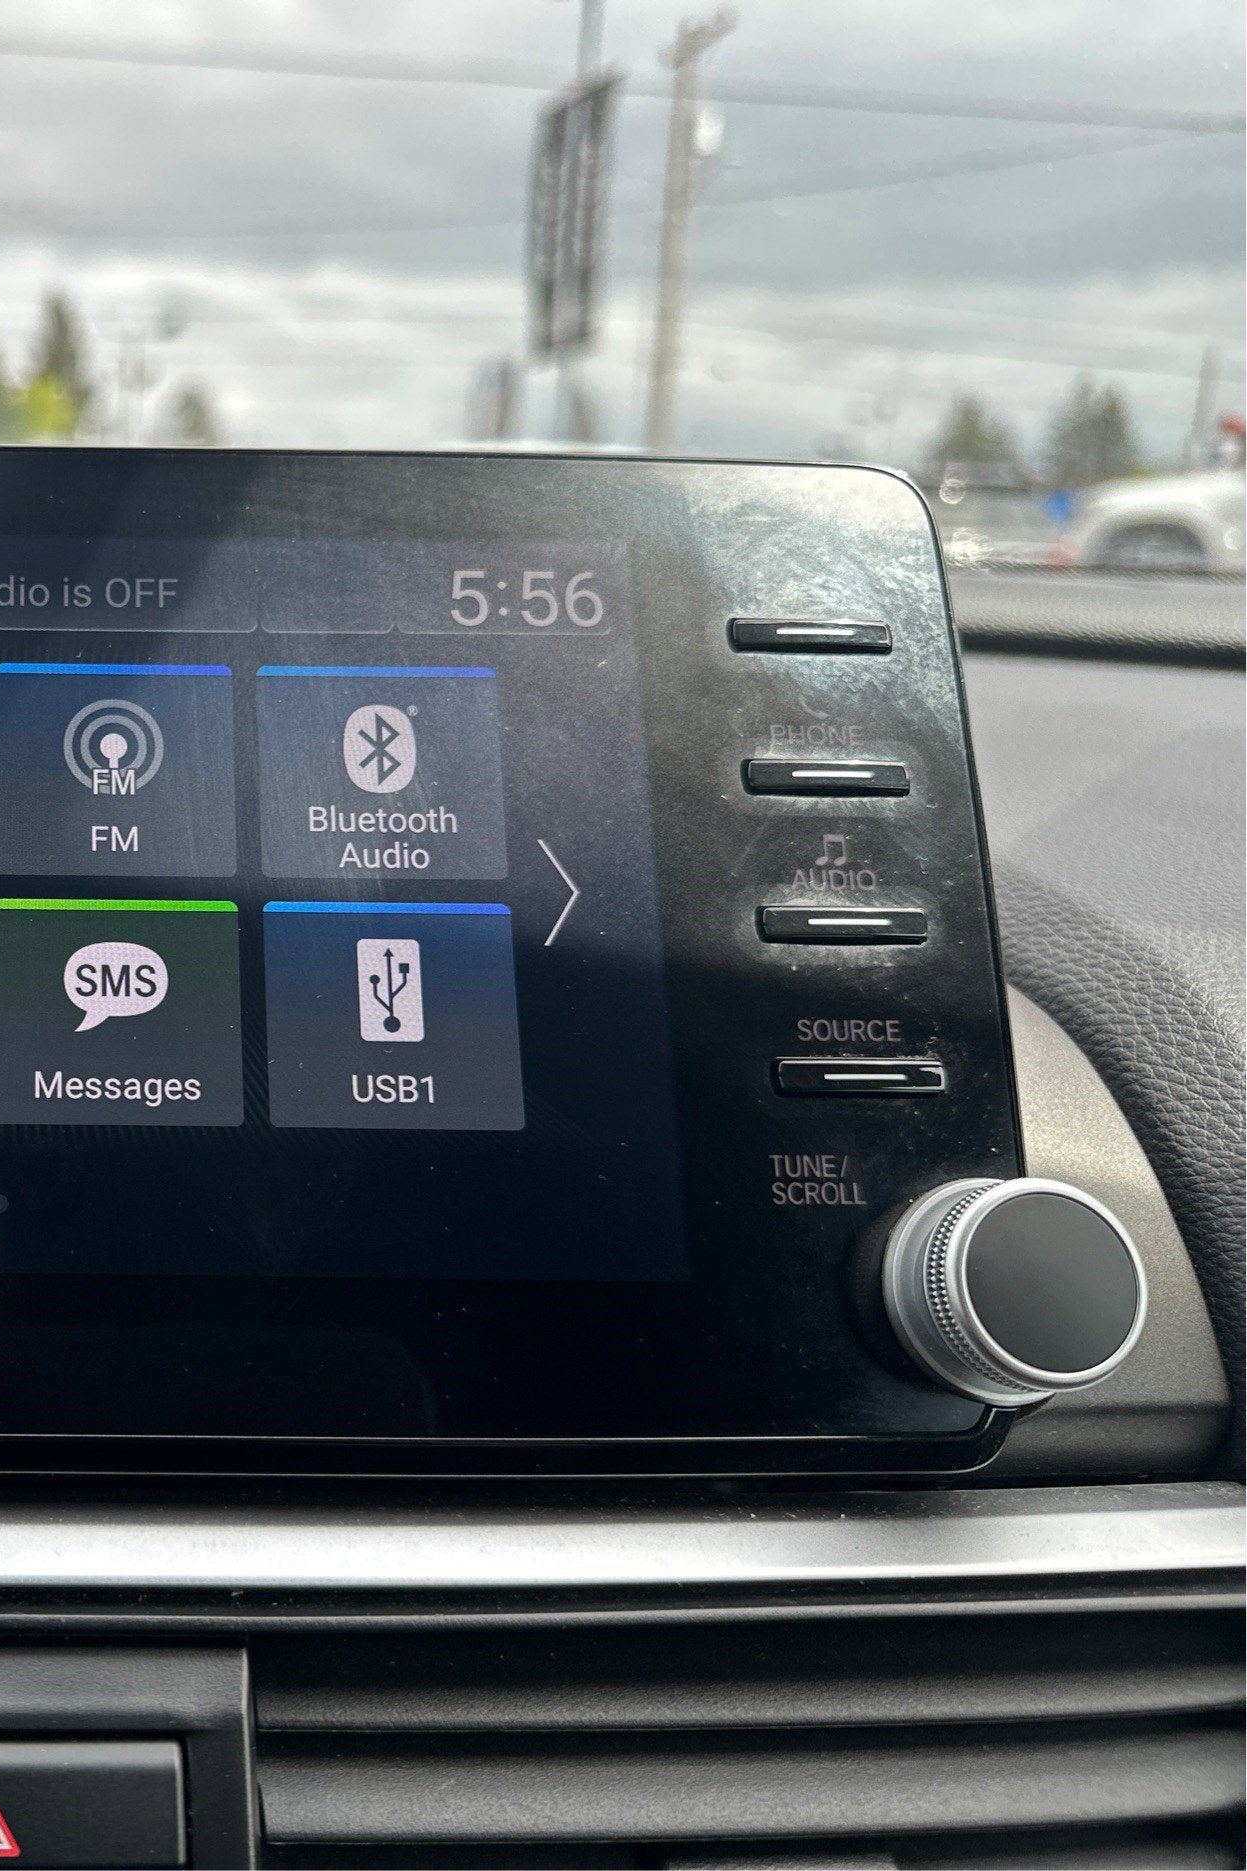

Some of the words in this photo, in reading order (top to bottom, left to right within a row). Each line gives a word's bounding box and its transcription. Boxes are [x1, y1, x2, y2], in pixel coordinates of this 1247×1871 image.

[63, 577, 92, 608] is
[104, 578, 179, 610] OFF
[451, 569, 606, 629] 5:56
[769, 725, 866, 746] PHONE
[93, 768, 136, 796] FM
[308, 807, 458, 835] Bluetooth
[90, 825, 140, 853] FM
[339, 842, 431, 871] Audio
[792, 870, 876, 890] AUDIO
[75, 963, 157, 998] SMS
[797, 1019, 902, 1042] SOURCE
[34, 1071, 202, 1106] Messages
[351, 1074, 436, 1104] USB1
[769, 1154, 848, 1178] TUNE/
[771, 1182, 867, 1206] SCROLL
